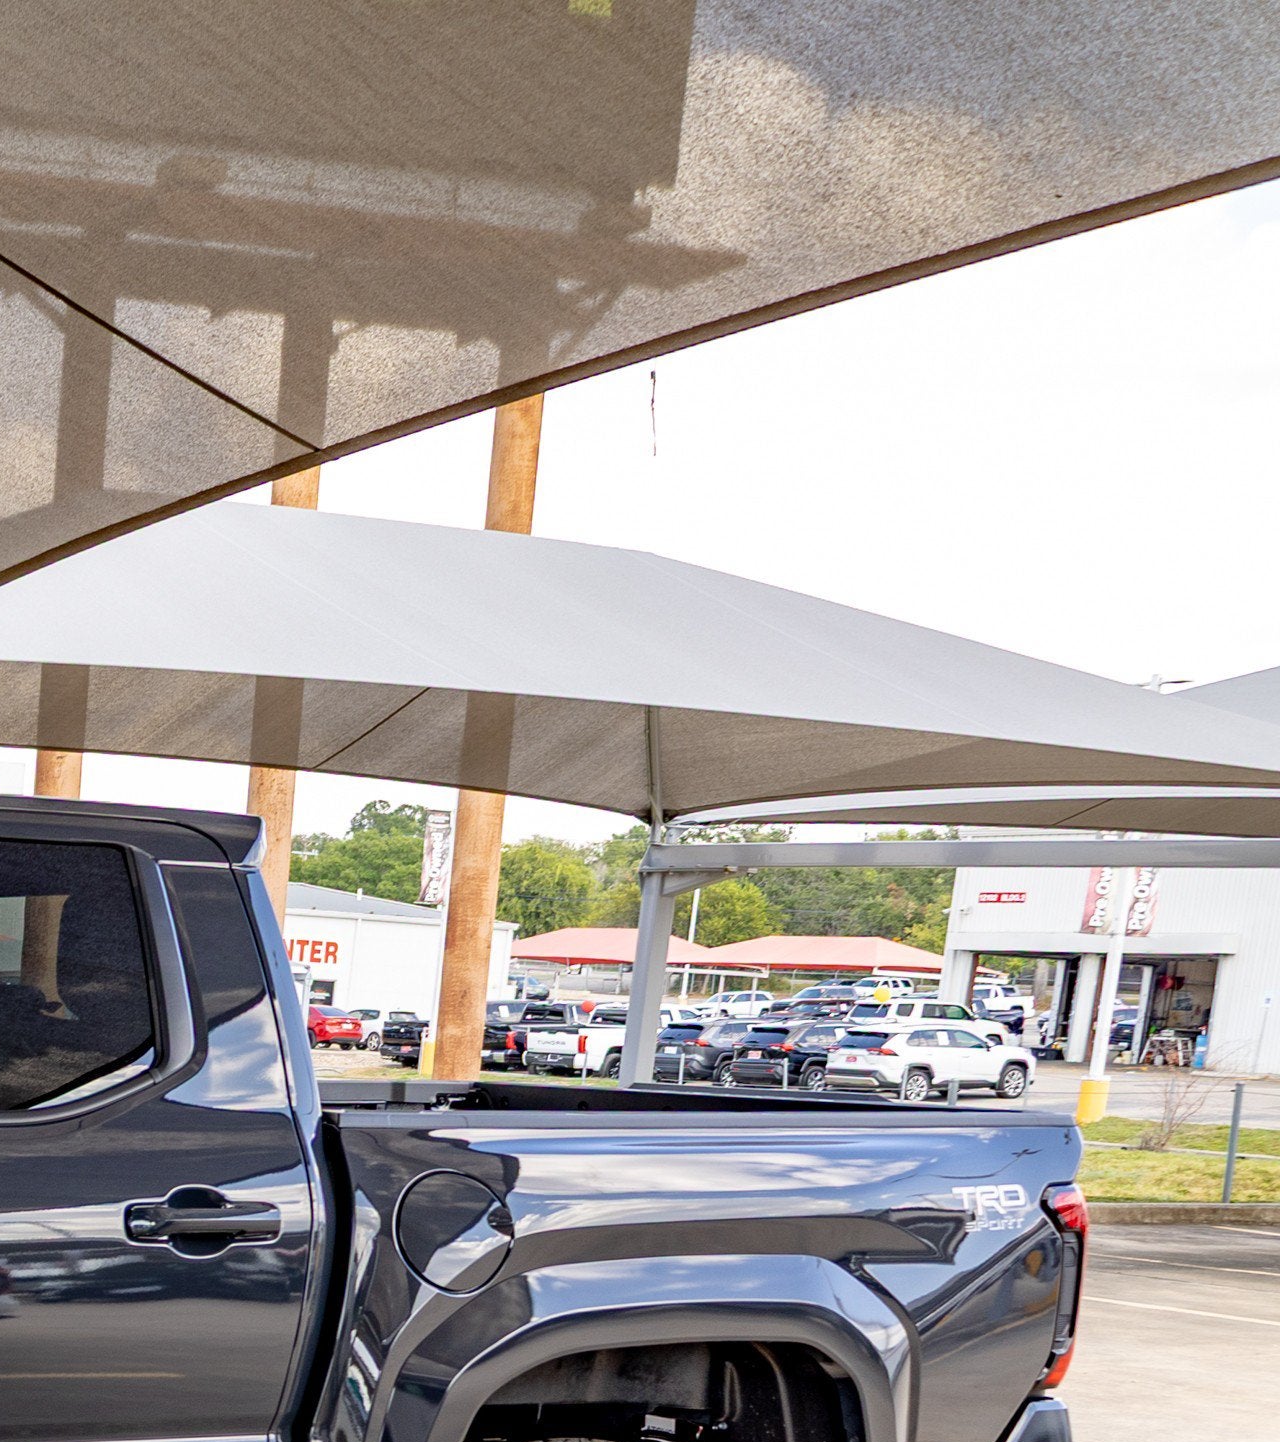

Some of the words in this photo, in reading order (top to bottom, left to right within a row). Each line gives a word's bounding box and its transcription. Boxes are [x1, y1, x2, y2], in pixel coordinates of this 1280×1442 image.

[1088, 897, 1107, 926] Pre
[1127, 901, 1148, 930] Pre
[951, 1183, 1026, 1216] TRD
[964, 1217, 1024, 1232] SPORT
